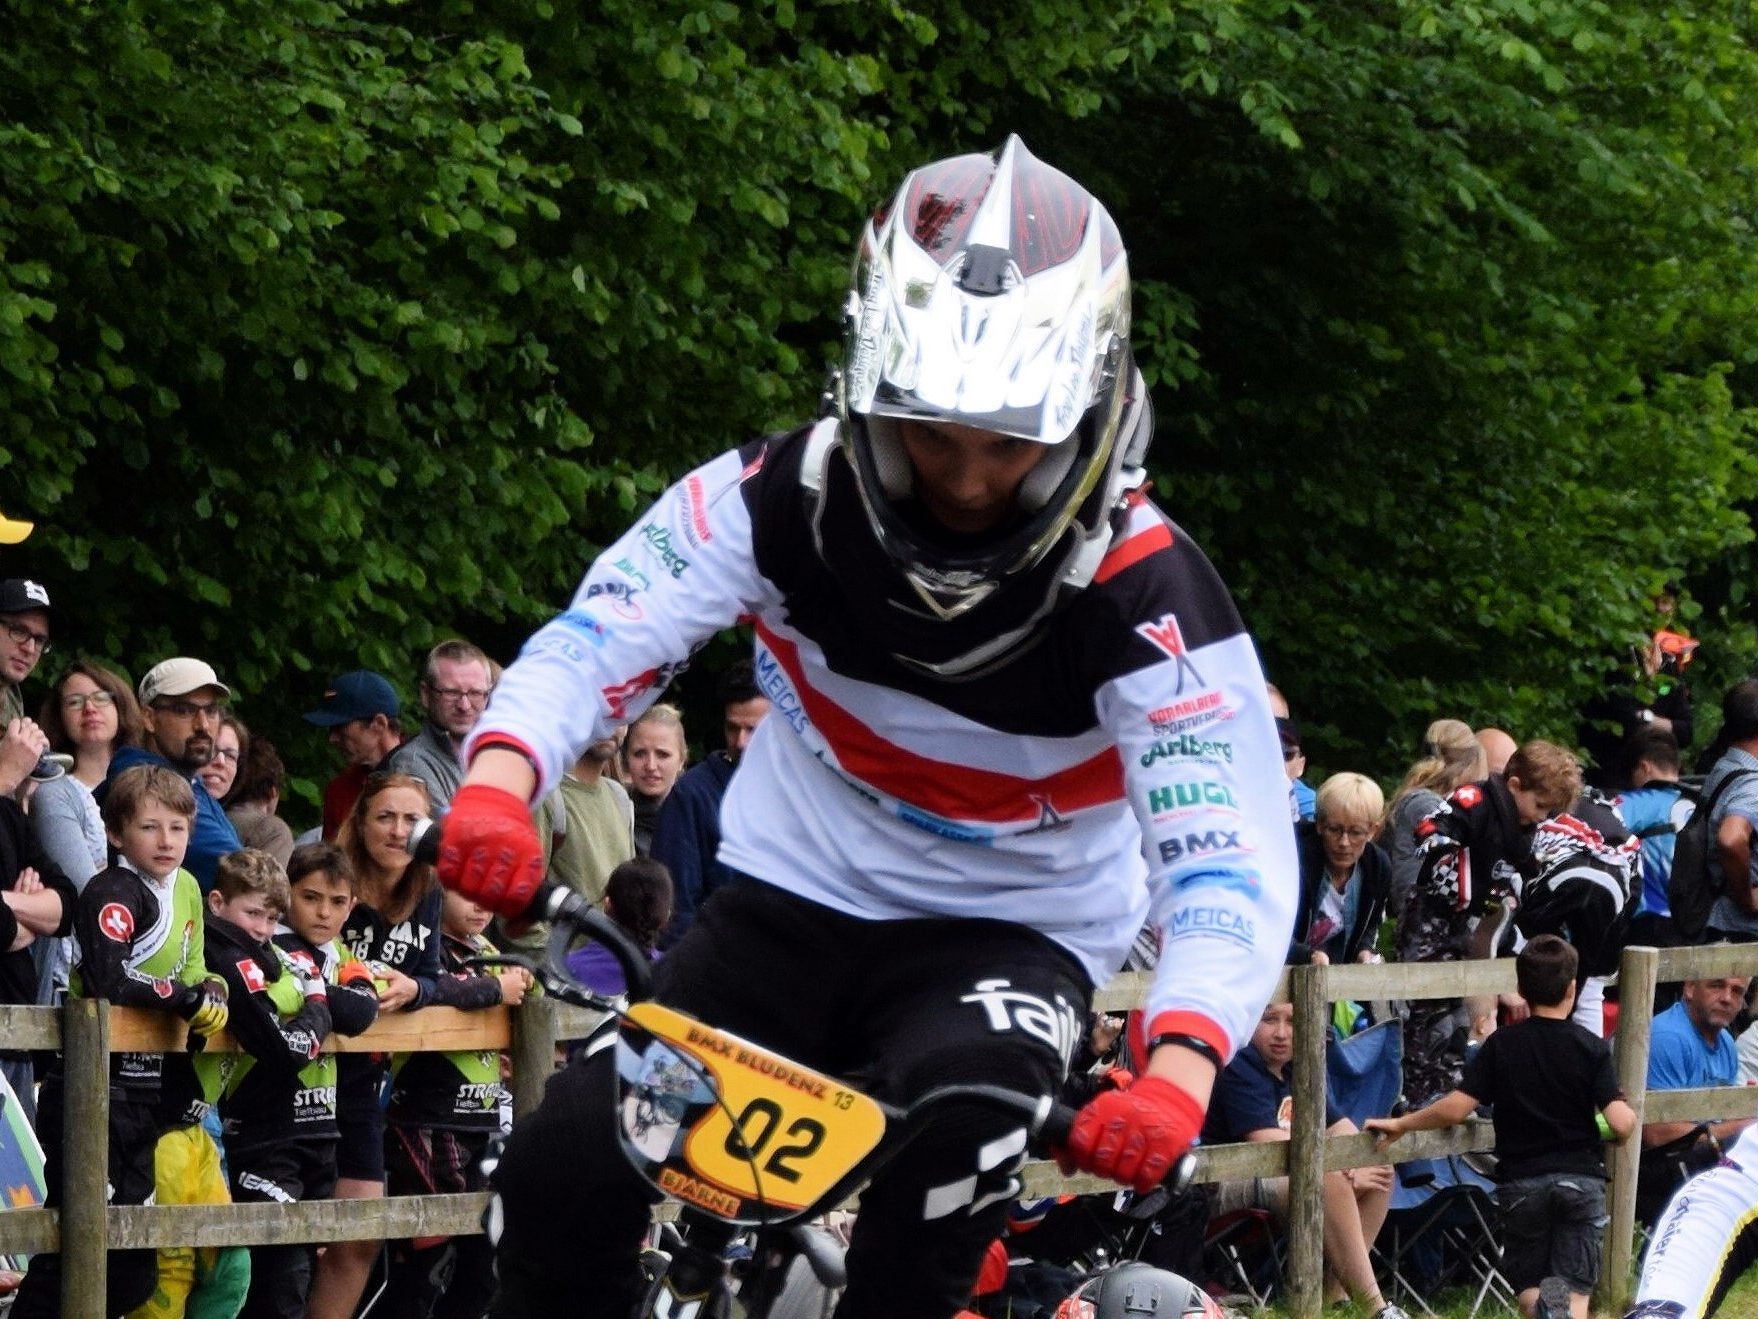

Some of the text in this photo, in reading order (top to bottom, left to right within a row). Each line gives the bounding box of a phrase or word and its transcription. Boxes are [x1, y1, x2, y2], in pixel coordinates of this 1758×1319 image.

[1141, 733, 1232, 768] Arlberg
[1158, 830, 1239, 864] BMX
[1172, 907, 1255, 938] MEICAS
[381, 940, 408, 965] 93
[686, 1027, 855, 1111] BMX BLUDENZ 13
[724, 1097, 827, 1184] 02
[661, 1171, 741, 1216] BJARNE
